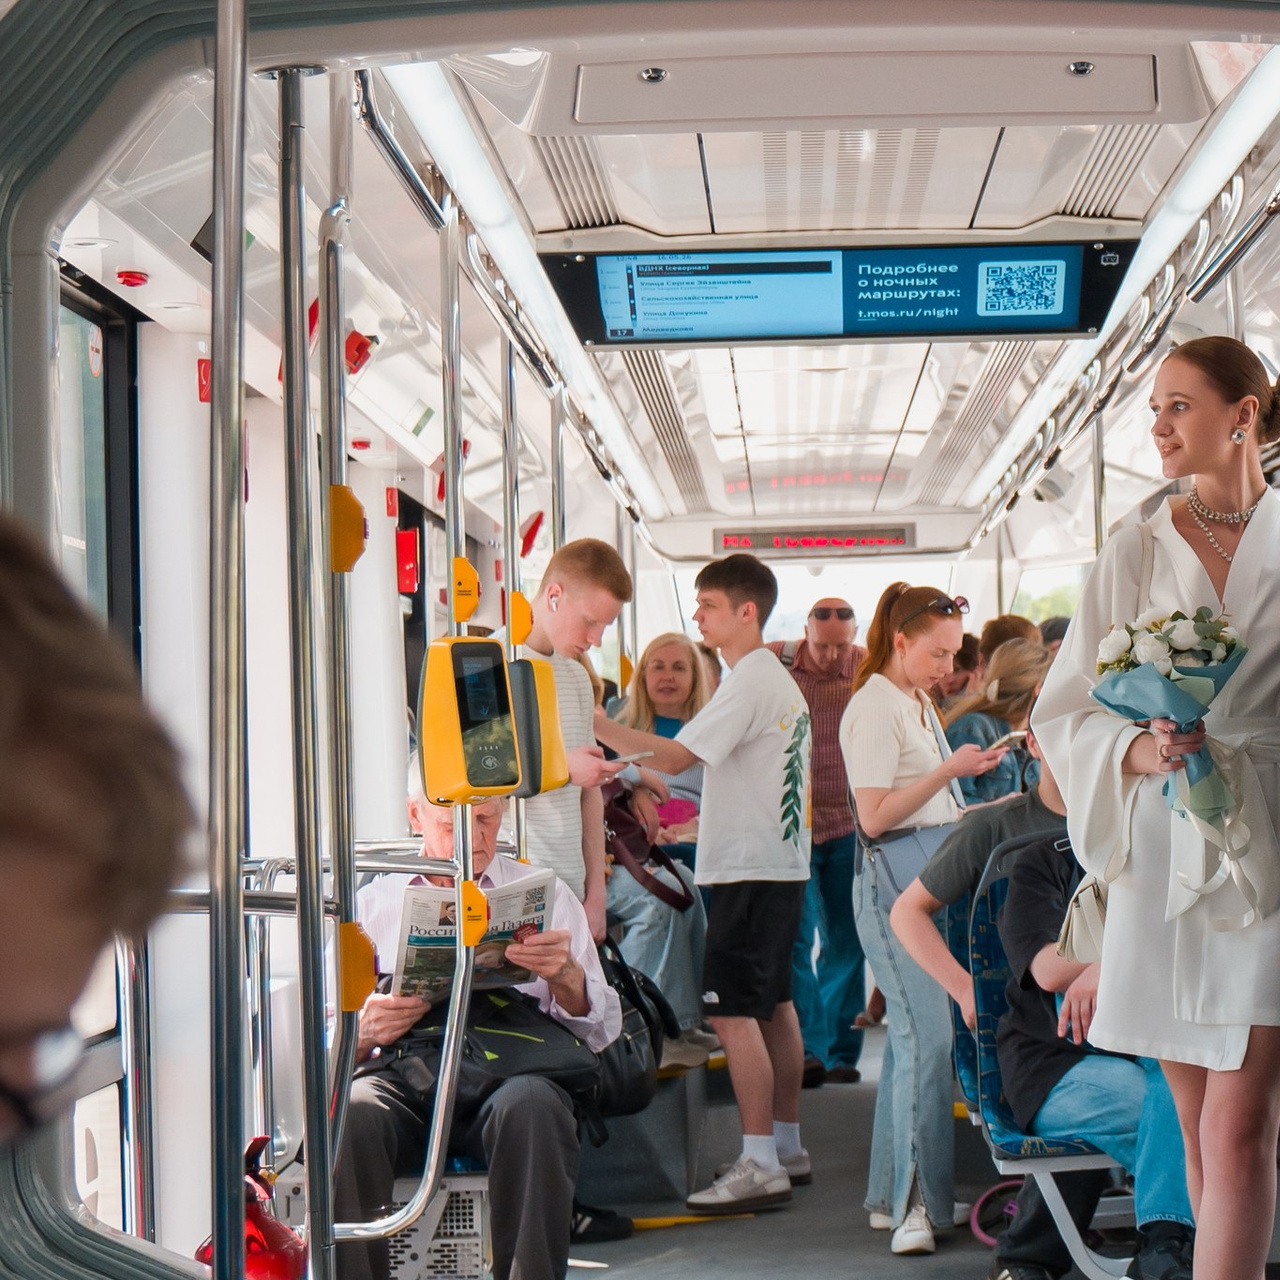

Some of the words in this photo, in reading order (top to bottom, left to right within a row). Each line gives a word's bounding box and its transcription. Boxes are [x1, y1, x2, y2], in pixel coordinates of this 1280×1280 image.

[858, 263, 959, 276] Подробнее
[858, 279, 869, 287] о
[873, 277, 938, 287] ночных
[858, 289, 961, 301] маршрутах:
[858, 307, 959, 319] t.mos.ru/night
